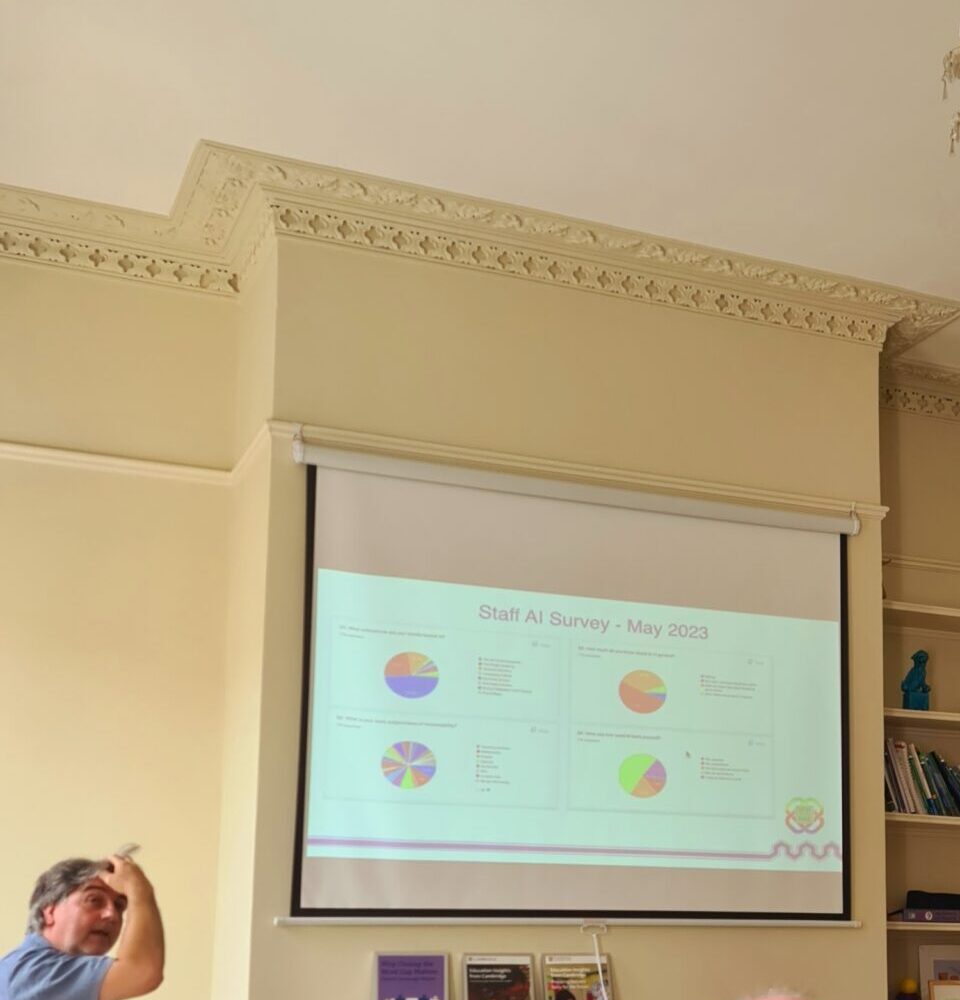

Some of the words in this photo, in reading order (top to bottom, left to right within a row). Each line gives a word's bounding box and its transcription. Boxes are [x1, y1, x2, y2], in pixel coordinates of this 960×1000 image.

[478, 604, 520, 623] Staff
[525, 609, 543, 624] AI
[549, 610, 610, 634] Survey
[627, 618, 663, 639] May
[668, 622, 709, 640] 2023
